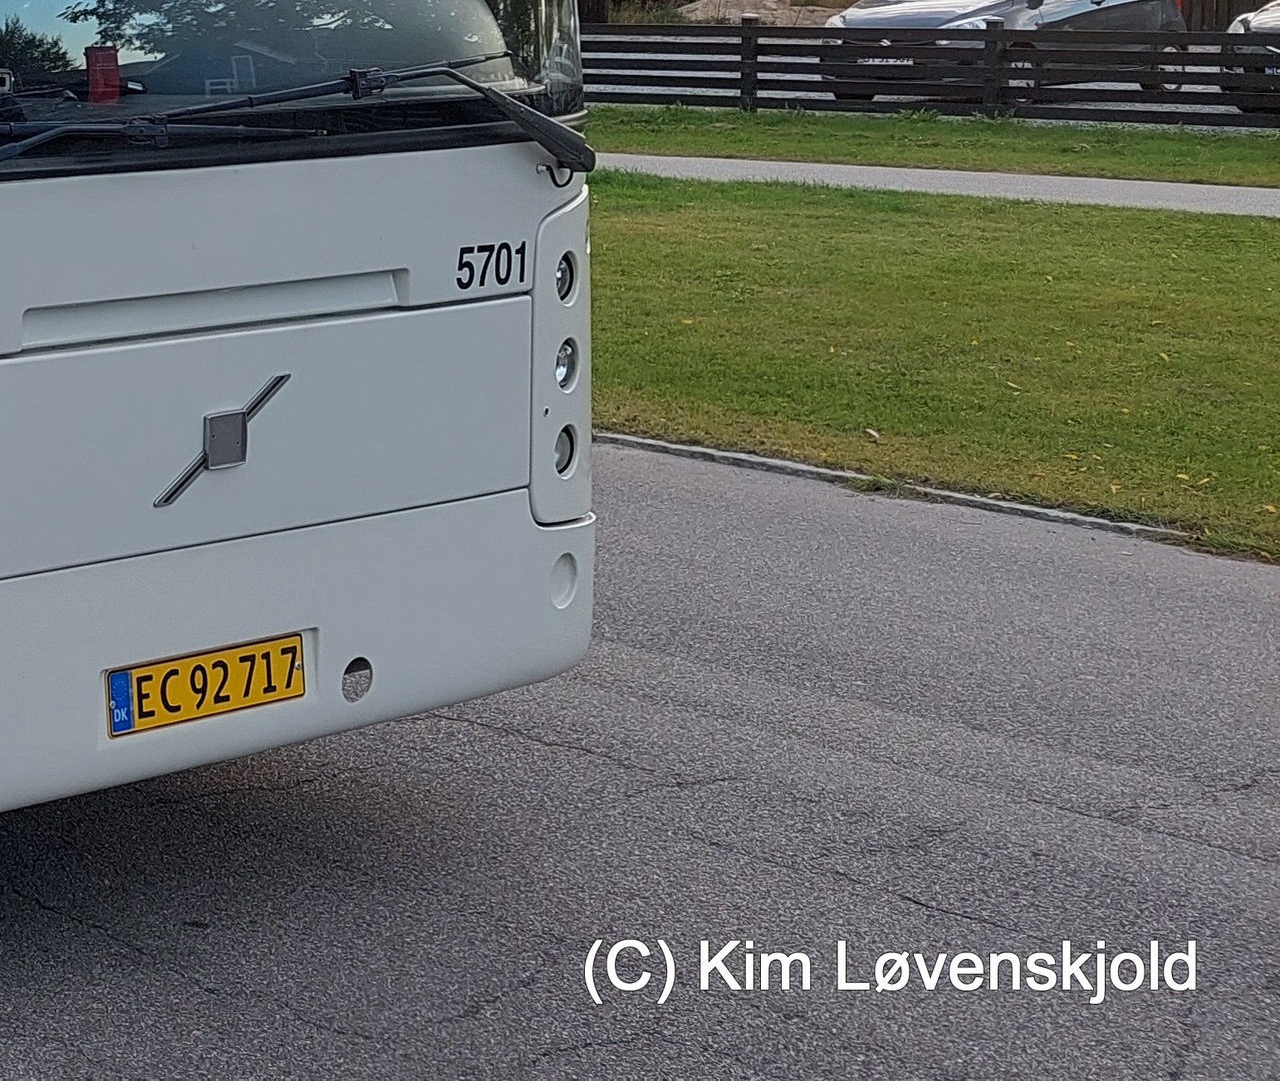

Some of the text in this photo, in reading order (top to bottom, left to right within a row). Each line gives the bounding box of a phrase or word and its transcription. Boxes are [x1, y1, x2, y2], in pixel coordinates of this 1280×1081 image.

[456, 241, 526, 290] 5701
[136, 645, 298, 719] EC 92 717
[114, 707, 128, 723] DK
